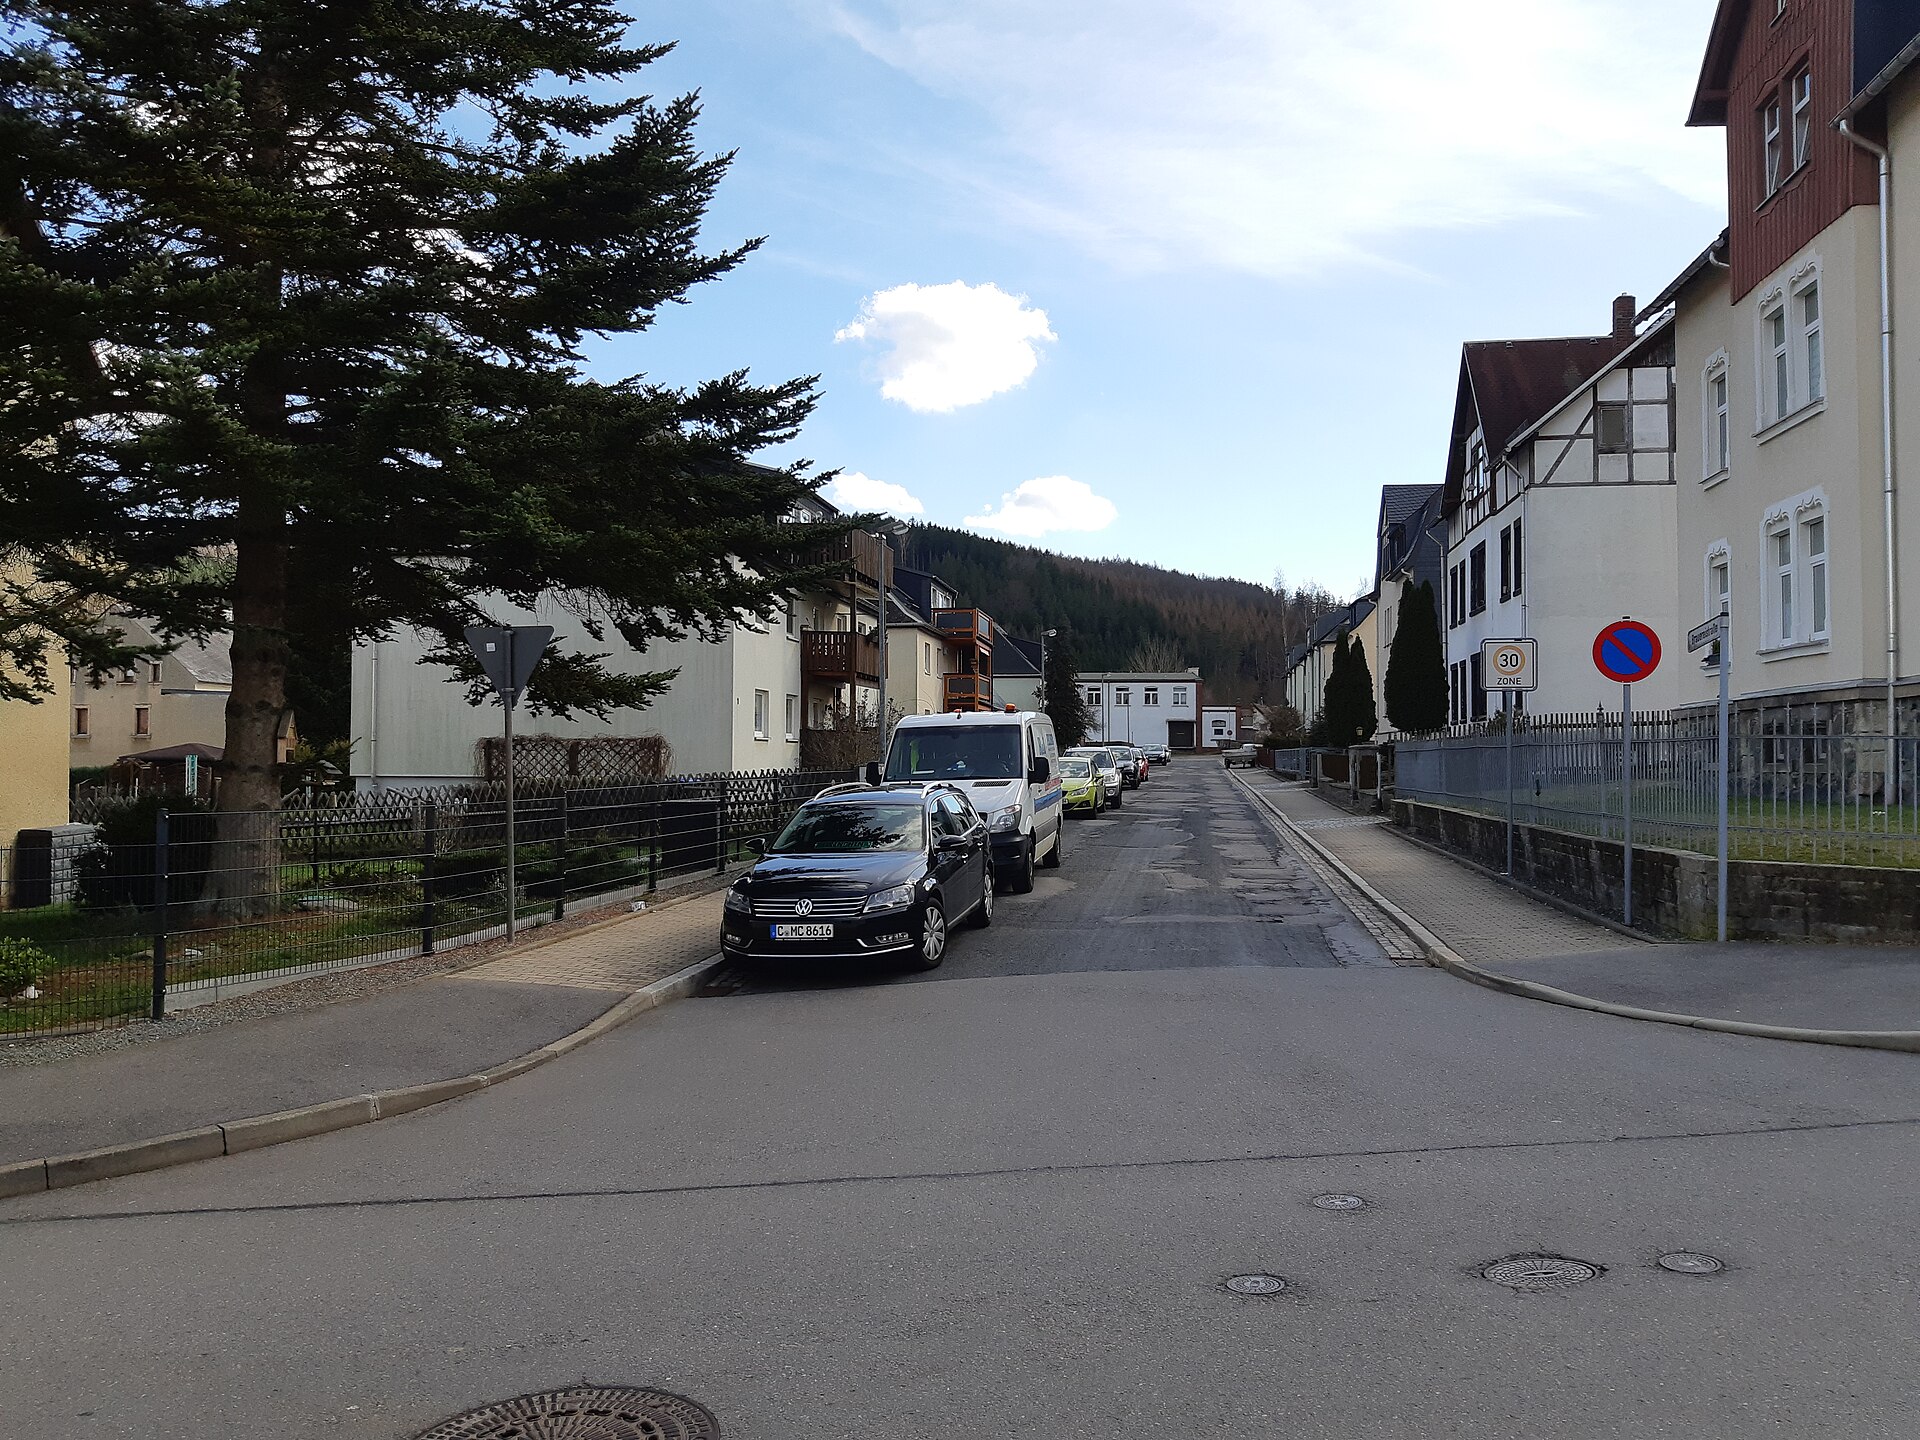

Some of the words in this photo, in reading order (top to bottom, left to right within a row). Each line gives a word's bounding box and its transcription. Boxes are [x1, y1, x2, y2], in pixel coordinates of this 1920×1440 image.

[1499, 654, 1519, 667] 30
[1497, 677, 1522, 686] ZONE
[806, 925, 832, 936] 8616
